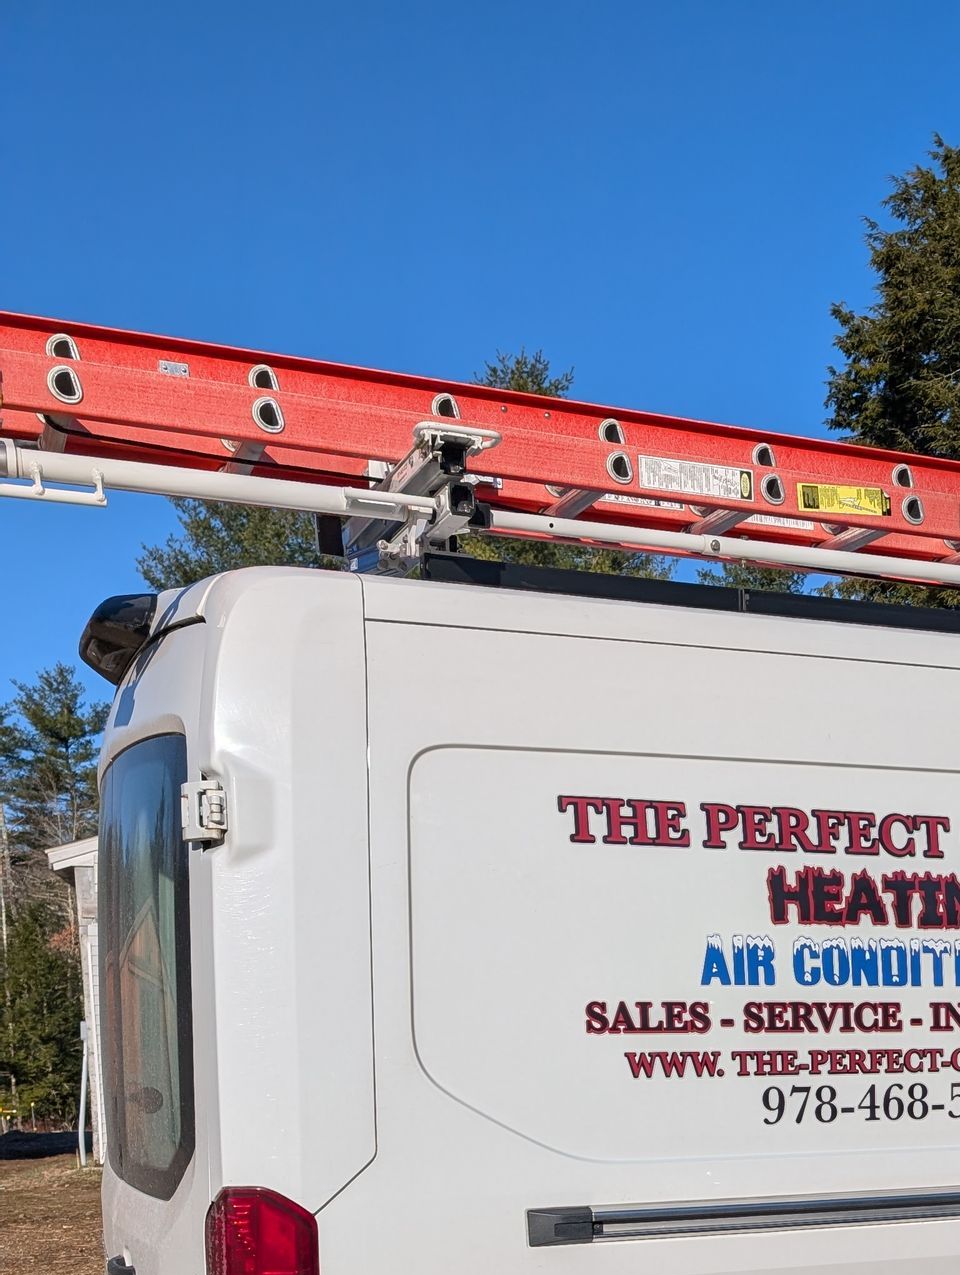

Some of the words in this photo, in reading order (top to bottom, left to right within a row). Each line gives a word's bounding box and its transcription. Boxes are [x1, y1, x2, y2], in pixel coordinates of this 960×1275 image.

[557, 795, 690, 848] THE
[700, 803, 950, 859] PERFECT
[700, 934, 776, 987] AIR
[585, 1000, 712, 1034] SALES
[743, 1002, 903, 1033] SERVICE
[624, 1051, 724, 1078] WWW.
